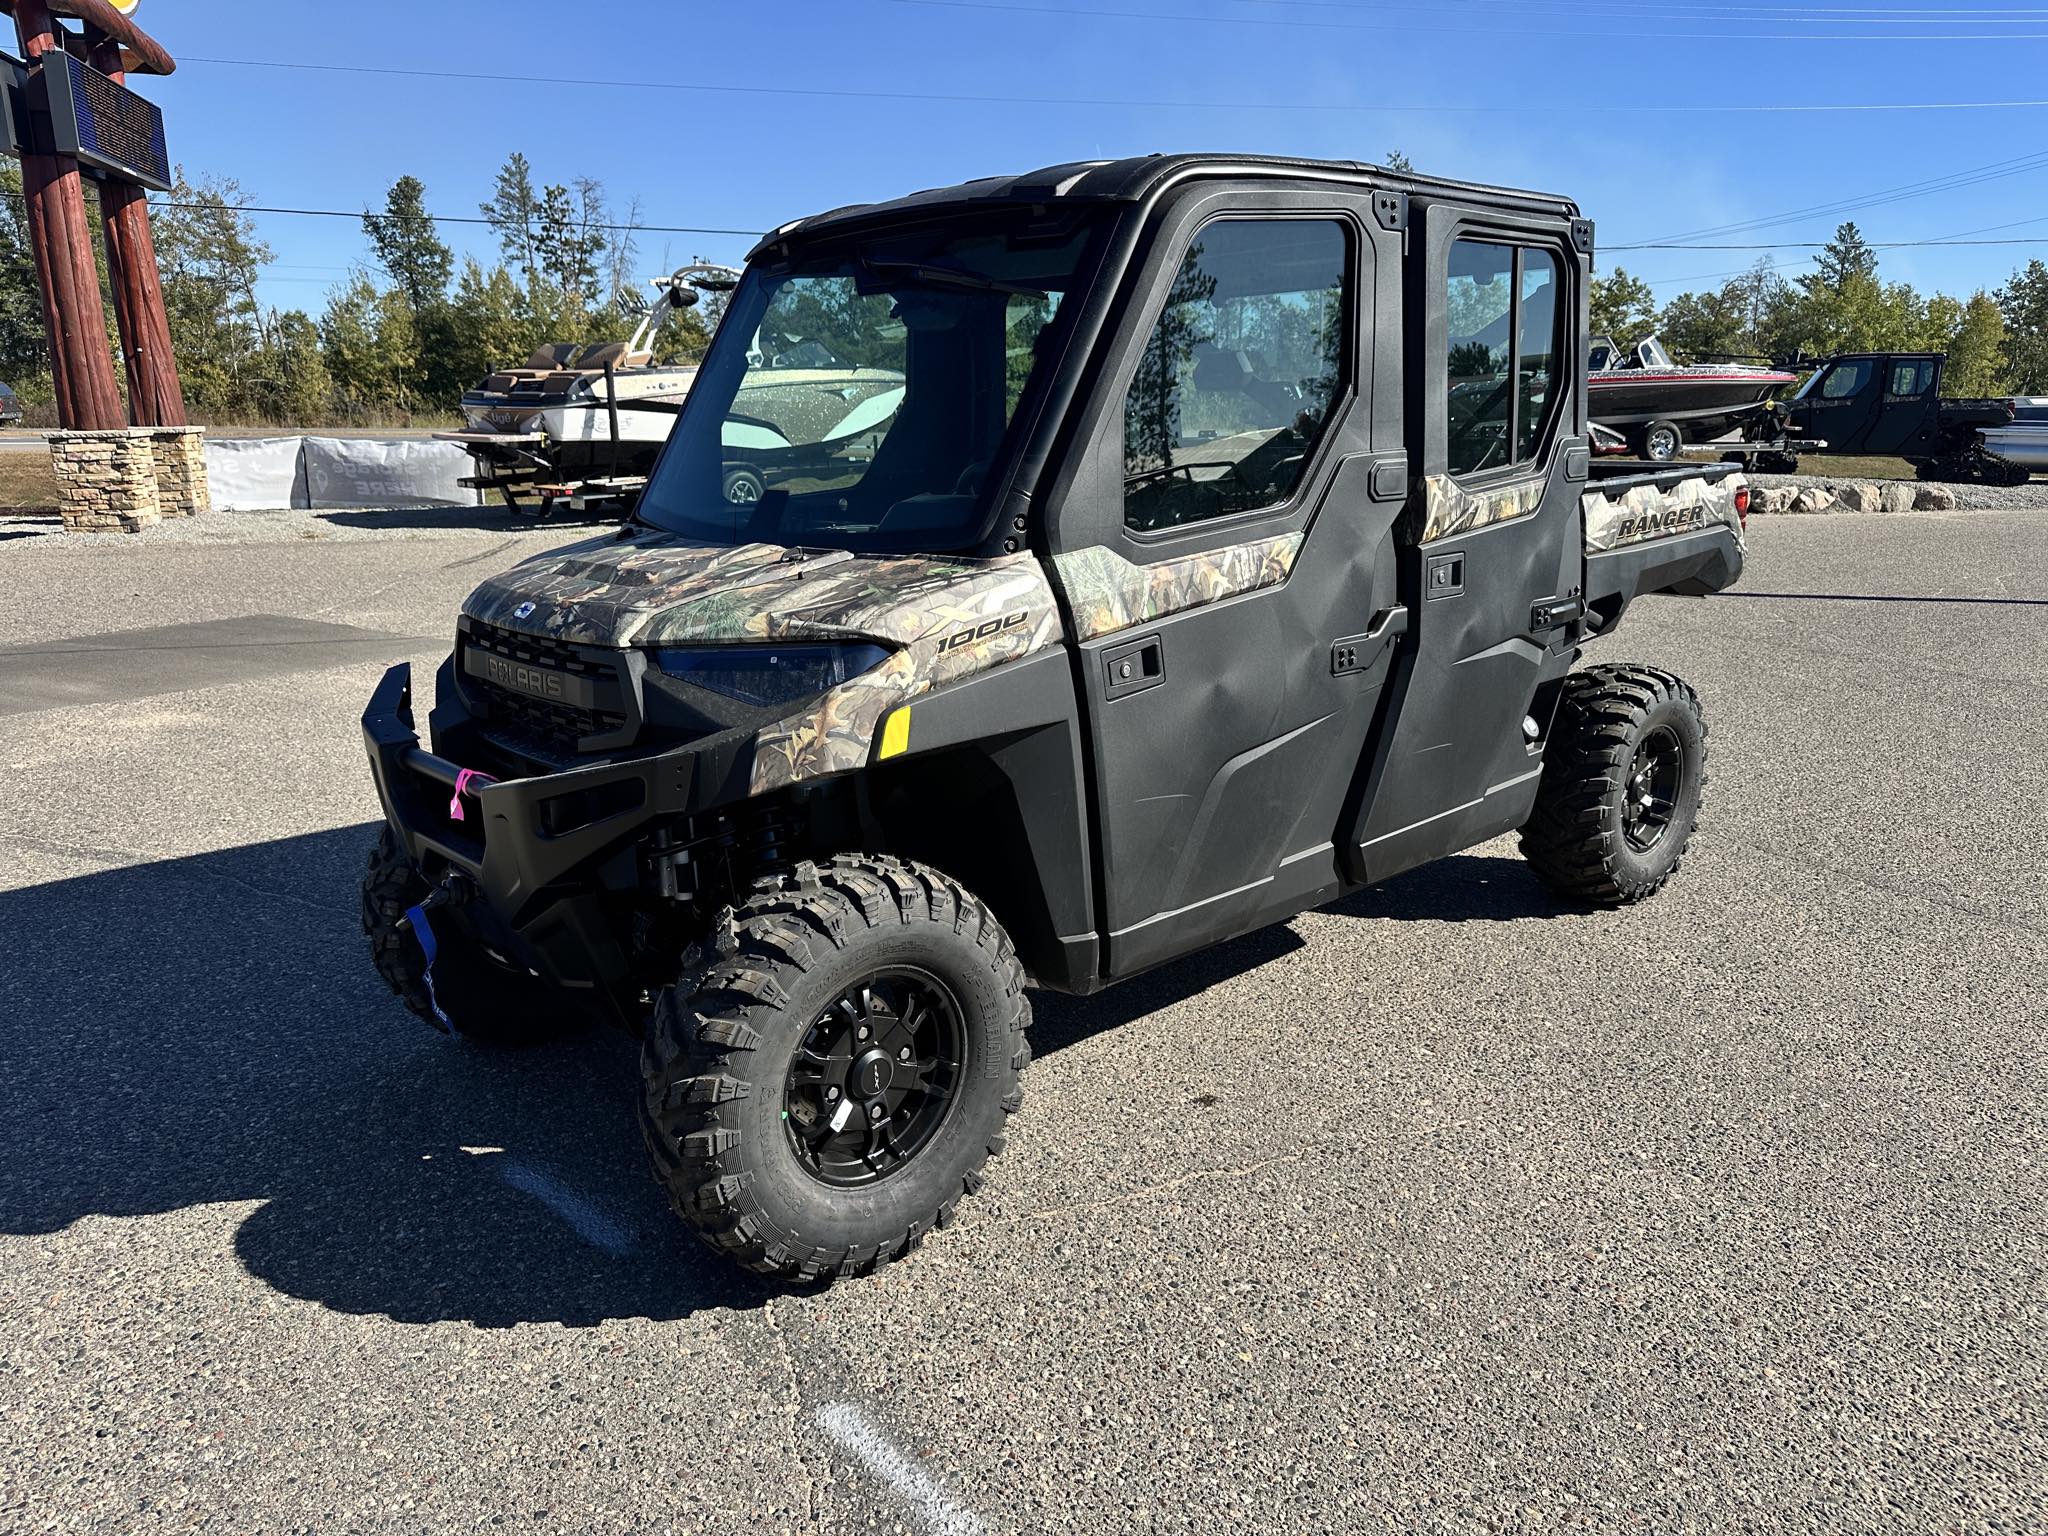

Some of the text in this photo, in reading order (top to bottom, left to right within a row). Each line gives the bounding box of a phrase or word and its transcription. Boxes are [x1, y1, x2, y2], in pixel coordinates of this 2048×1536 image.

[1616, 504, 1704, 539] RANGER
[937, 607, 1031, 655] 1000
[488, 656, 562, 697] POLARIS
